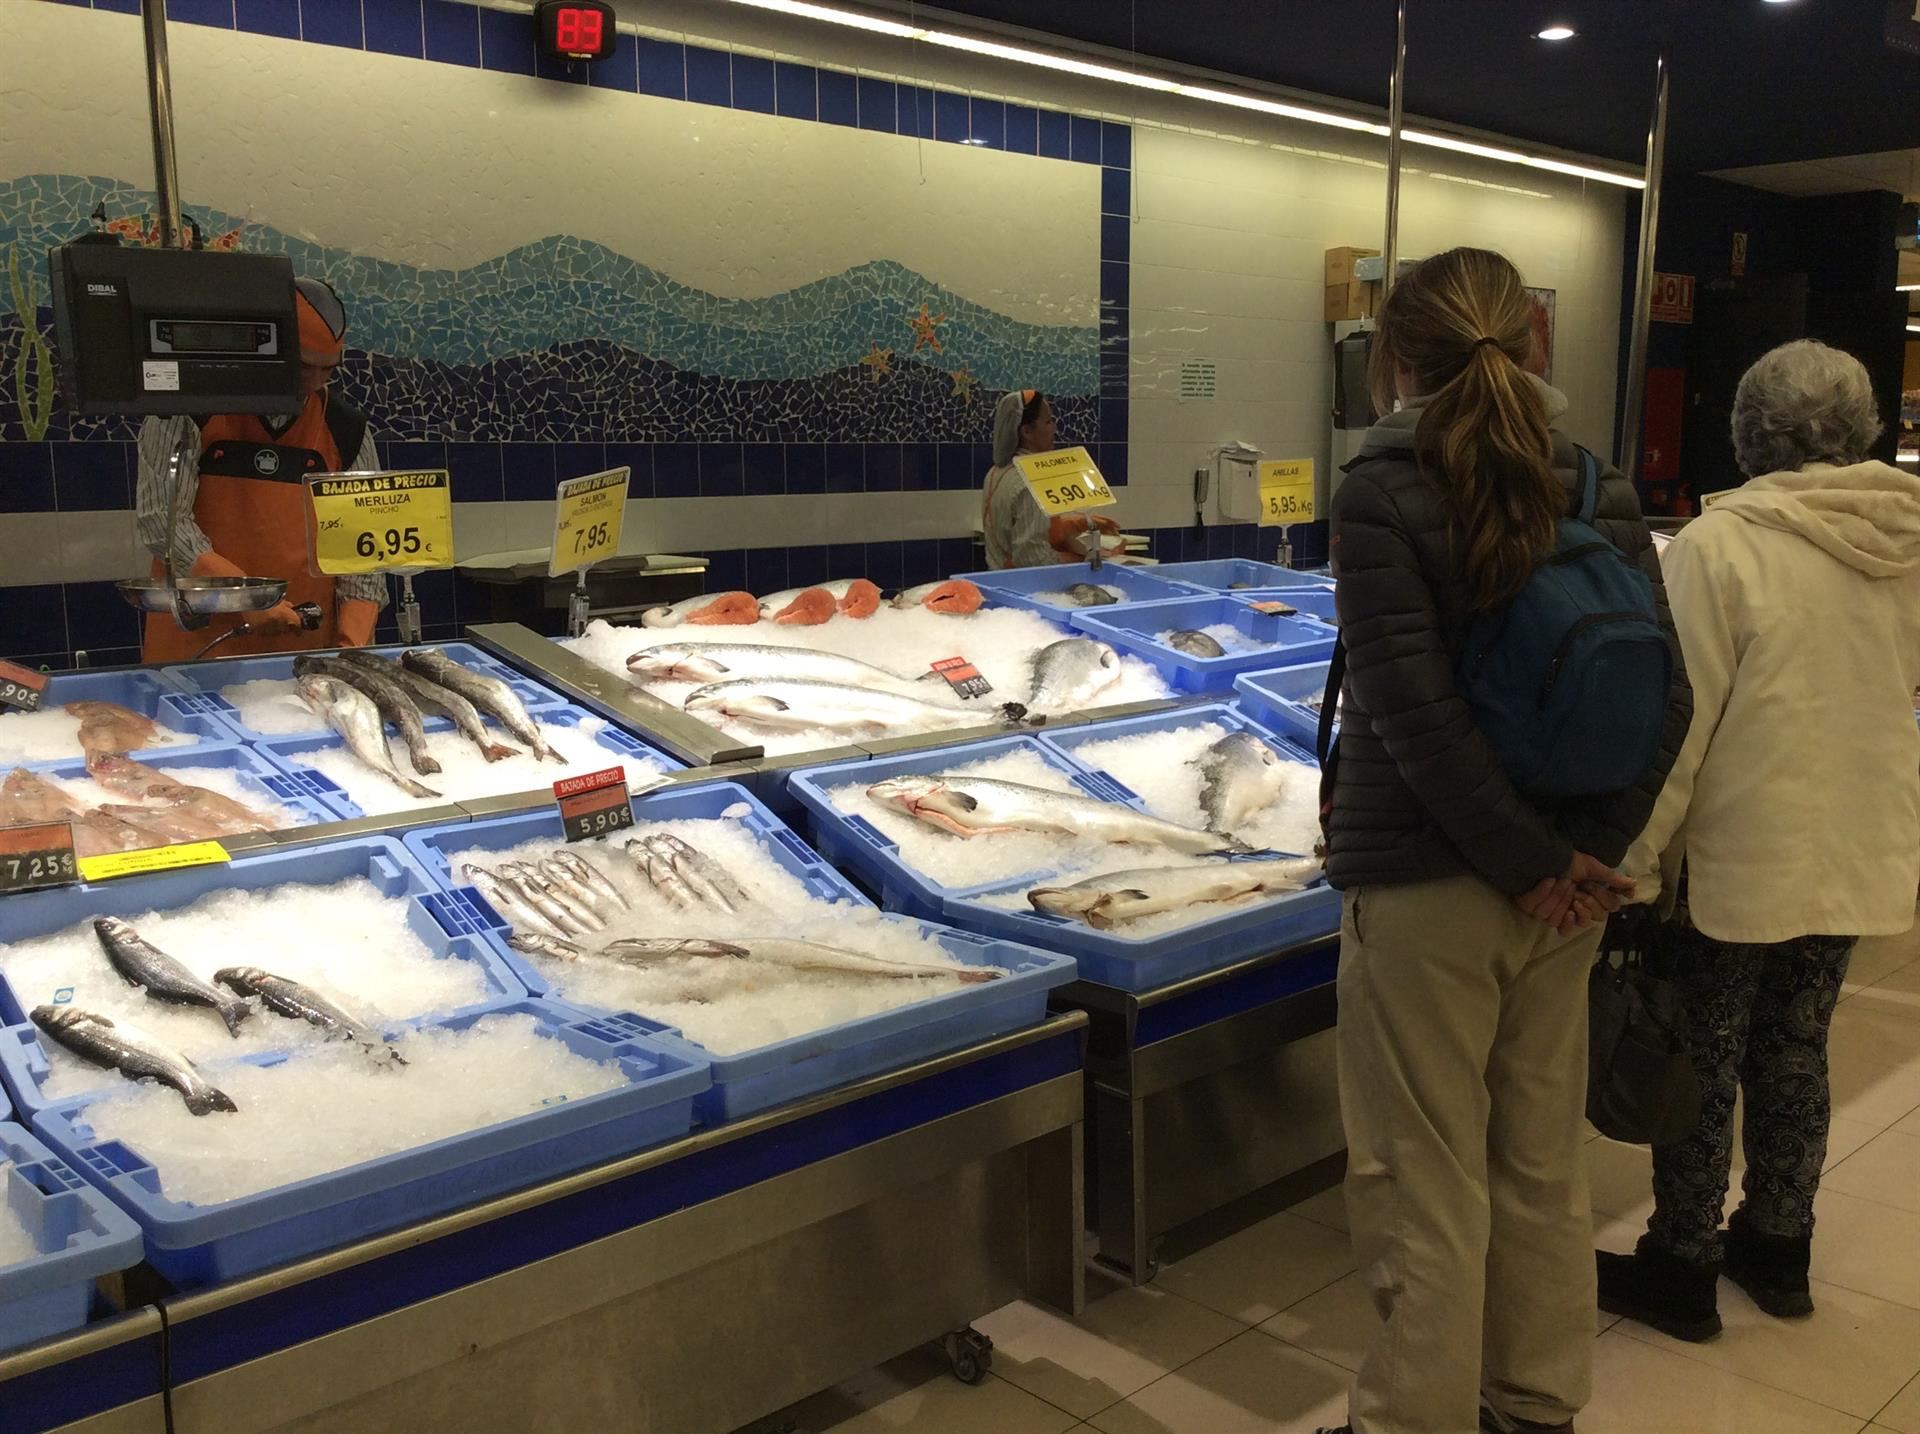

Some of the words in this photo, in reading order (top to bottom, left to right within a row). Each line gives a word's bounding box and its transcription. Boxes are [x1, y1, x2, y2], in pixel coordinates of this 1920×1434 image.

[557, 9, 602, 49] 83
[87, 284, 117, 293] DIBAL
[1034, 456, 1078, 469] PALOMETA
[1272, 467, 1299, 477] ANILLAS
[322, 481, 371, 495] BAJADA
[373, 479, 391, 490] DE
[393, 474, 438, 488] PRECIO
[1045, 484, 1086, 505] 5,90
[354, 494, 411, 508] MERLUZA
[369, 505, 400, 515] PINCHO
[1270, 496, 1297, 517] 5,95
[356, 527, 421, 561] 6,95
[574, 521, 608, 556] 7,95
[0, 681, 28, 701] ,90
[560, 778, 586, 793] BAJADA
[586, 774, 595, 787] DE
[596, 769, 619, 784] PRECIO
[580, 811, 619, 834] 5,90
[620, 806, 630, 817] €
[7, 855, 60, 880] 7,25
[61, 853, 73, 866] €
